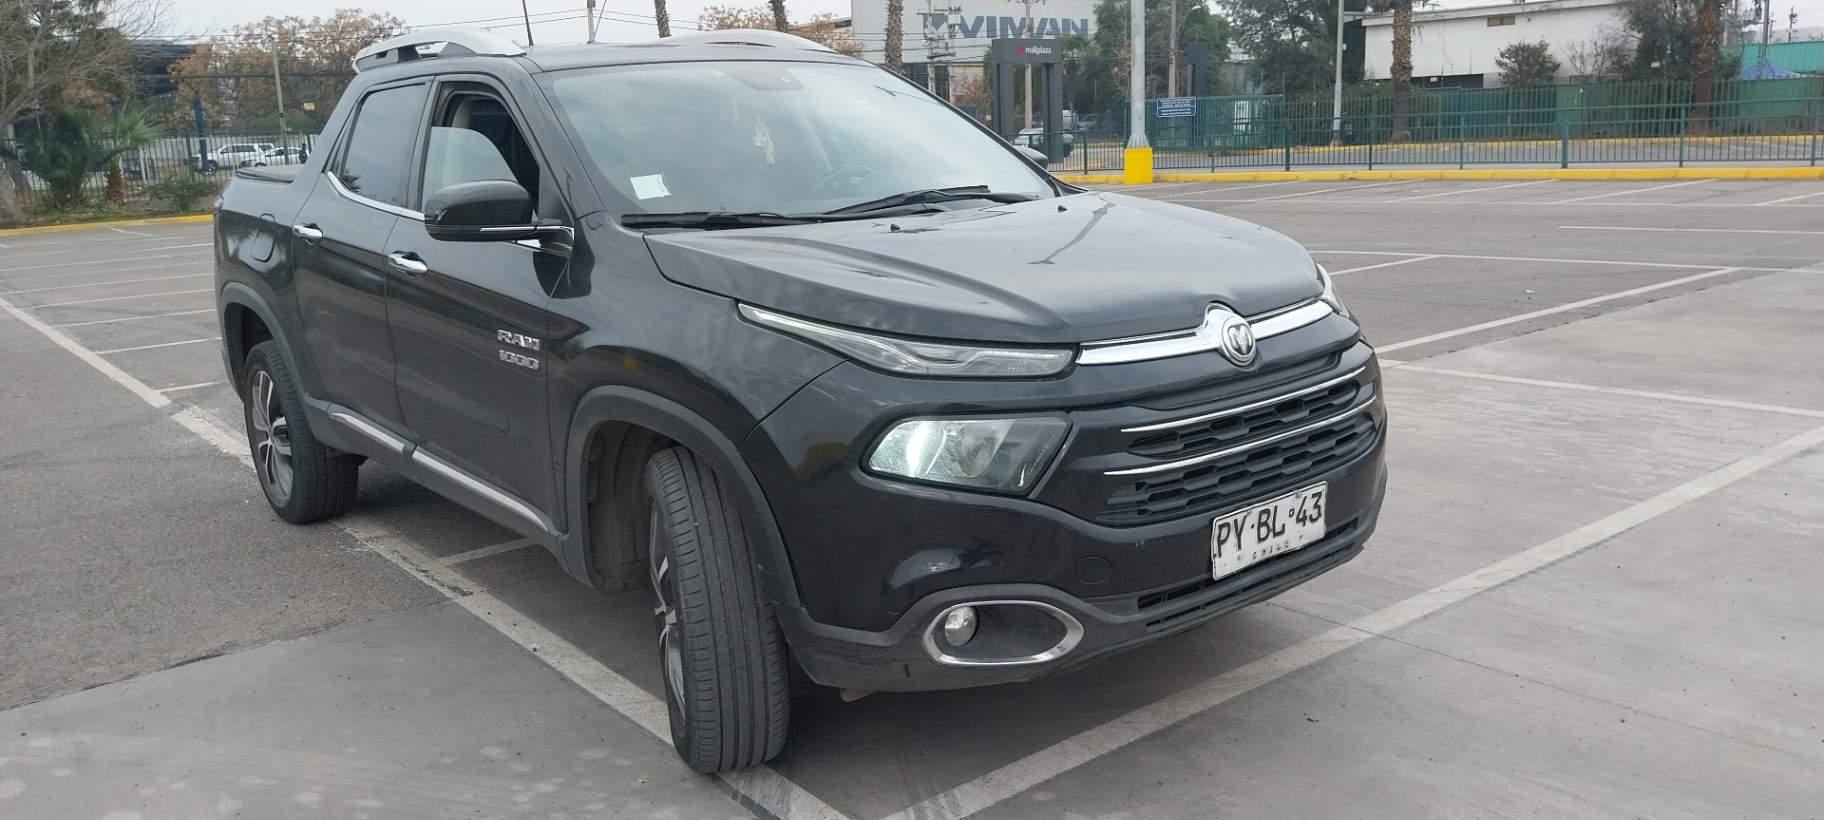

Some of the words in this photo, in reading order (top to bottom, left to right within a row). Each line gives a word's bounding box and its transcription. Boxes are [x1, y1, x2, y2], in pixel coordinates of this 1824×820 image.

[958, 15, 1089, 39] VIMAN
[497, 329, 540, 351] RAM
[499, 350, 540, 370] 1000
